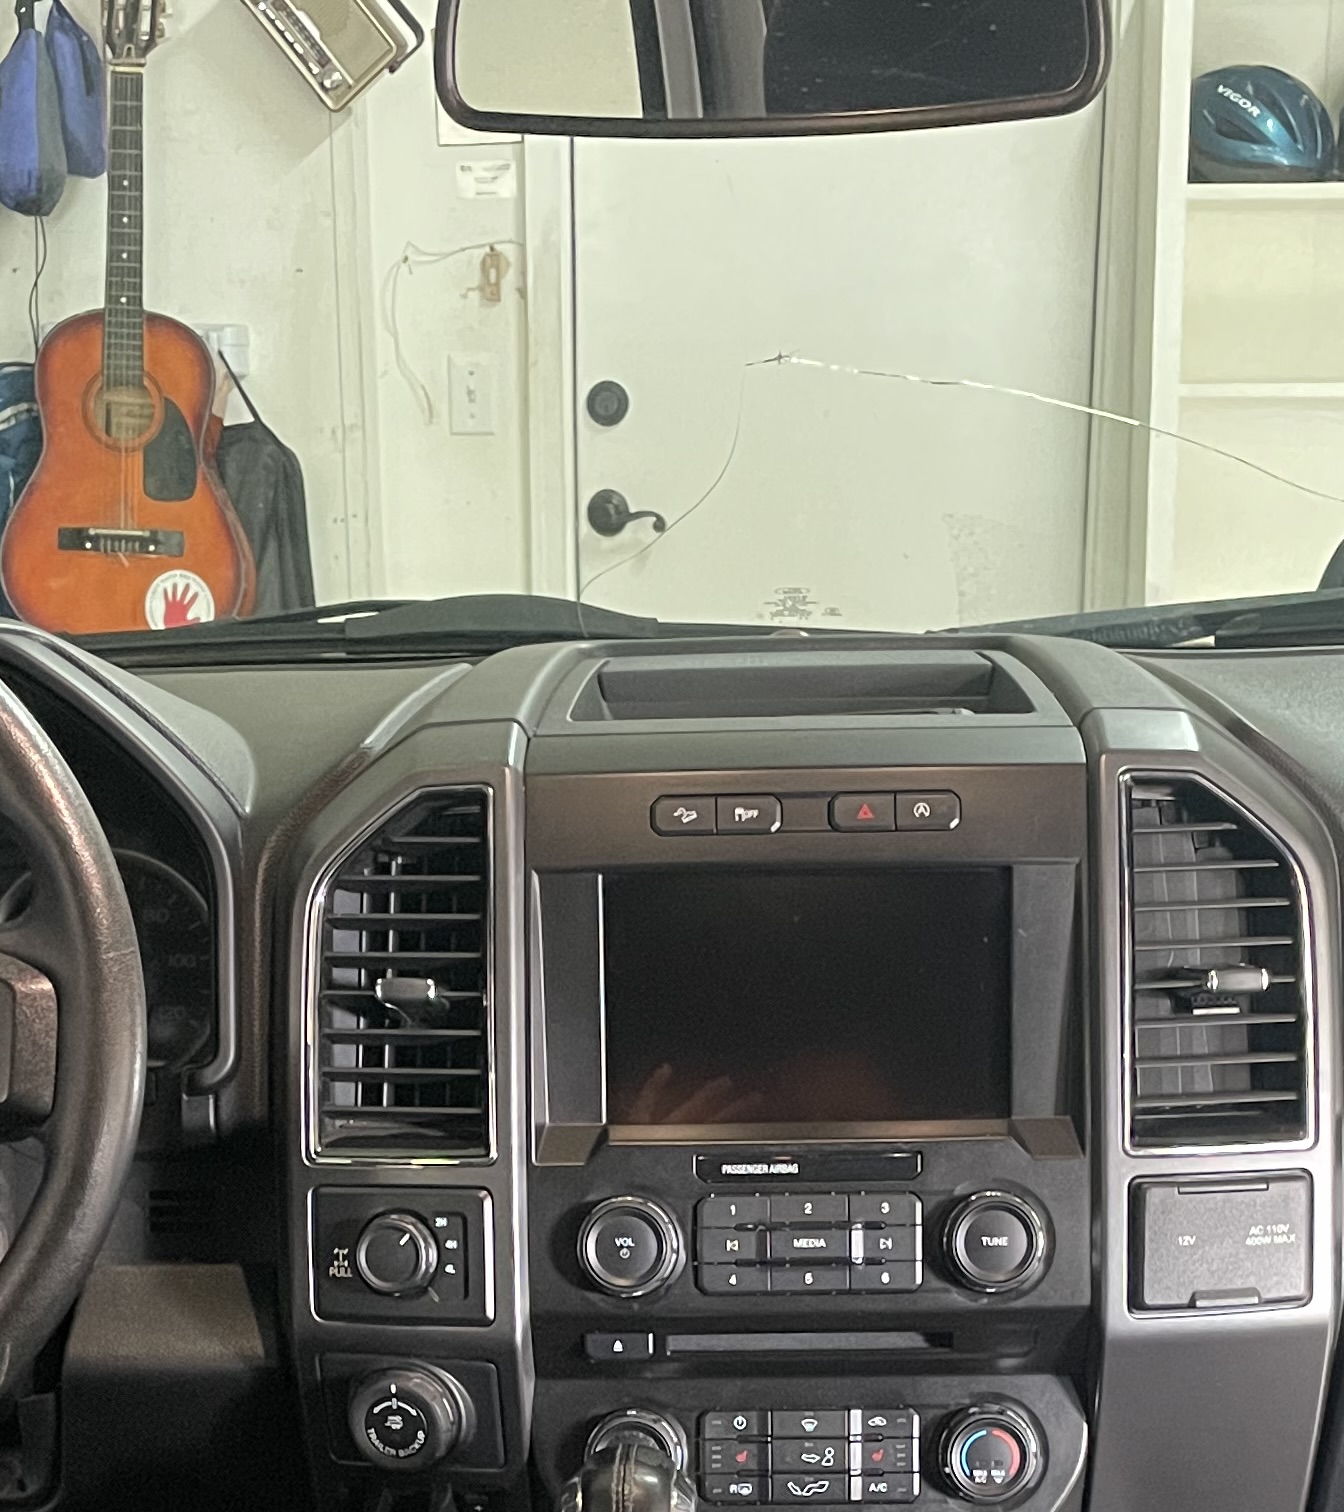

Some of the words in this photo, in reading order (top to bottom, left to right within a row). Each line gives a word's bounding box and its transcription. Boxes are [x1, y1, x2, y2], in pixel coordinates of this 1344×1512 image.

[1217, 84, 1261, 118] VIGOR
[721, 1164, 769, 1175] PASSENGER
[769, 1163, 799, 1174] AIRBAG
[729, 1205, 736, 1215] 1
[804, 1203, 813, 1214] 2
[880, 1202, 890, 1213] 3
[1248, 1225, 1264, 1236] AC
[1266, 1223, 1290, 1235] 110V
[614, 1237, 635, 1247] VOL
[793, 1238, 827, 1248] MEDIA
[981, 1236, 1008, 1246] TUNE
[1178, 1235, 1196, 1246] 12V
[1245, 1235, 1272, 1246] 400W
[1273, 1233, 1296, 1244] MAX
[328, 1266, 353, 1277] PULL
[728, 1274, 737, 1285] 4
[804, 1273, 814, 1285] 5
[367, 1427, 397, 1456] TRAILER
[397, 1430, 425, 1457] BACKUP
[869, 1483, 888, 1492] A/C
